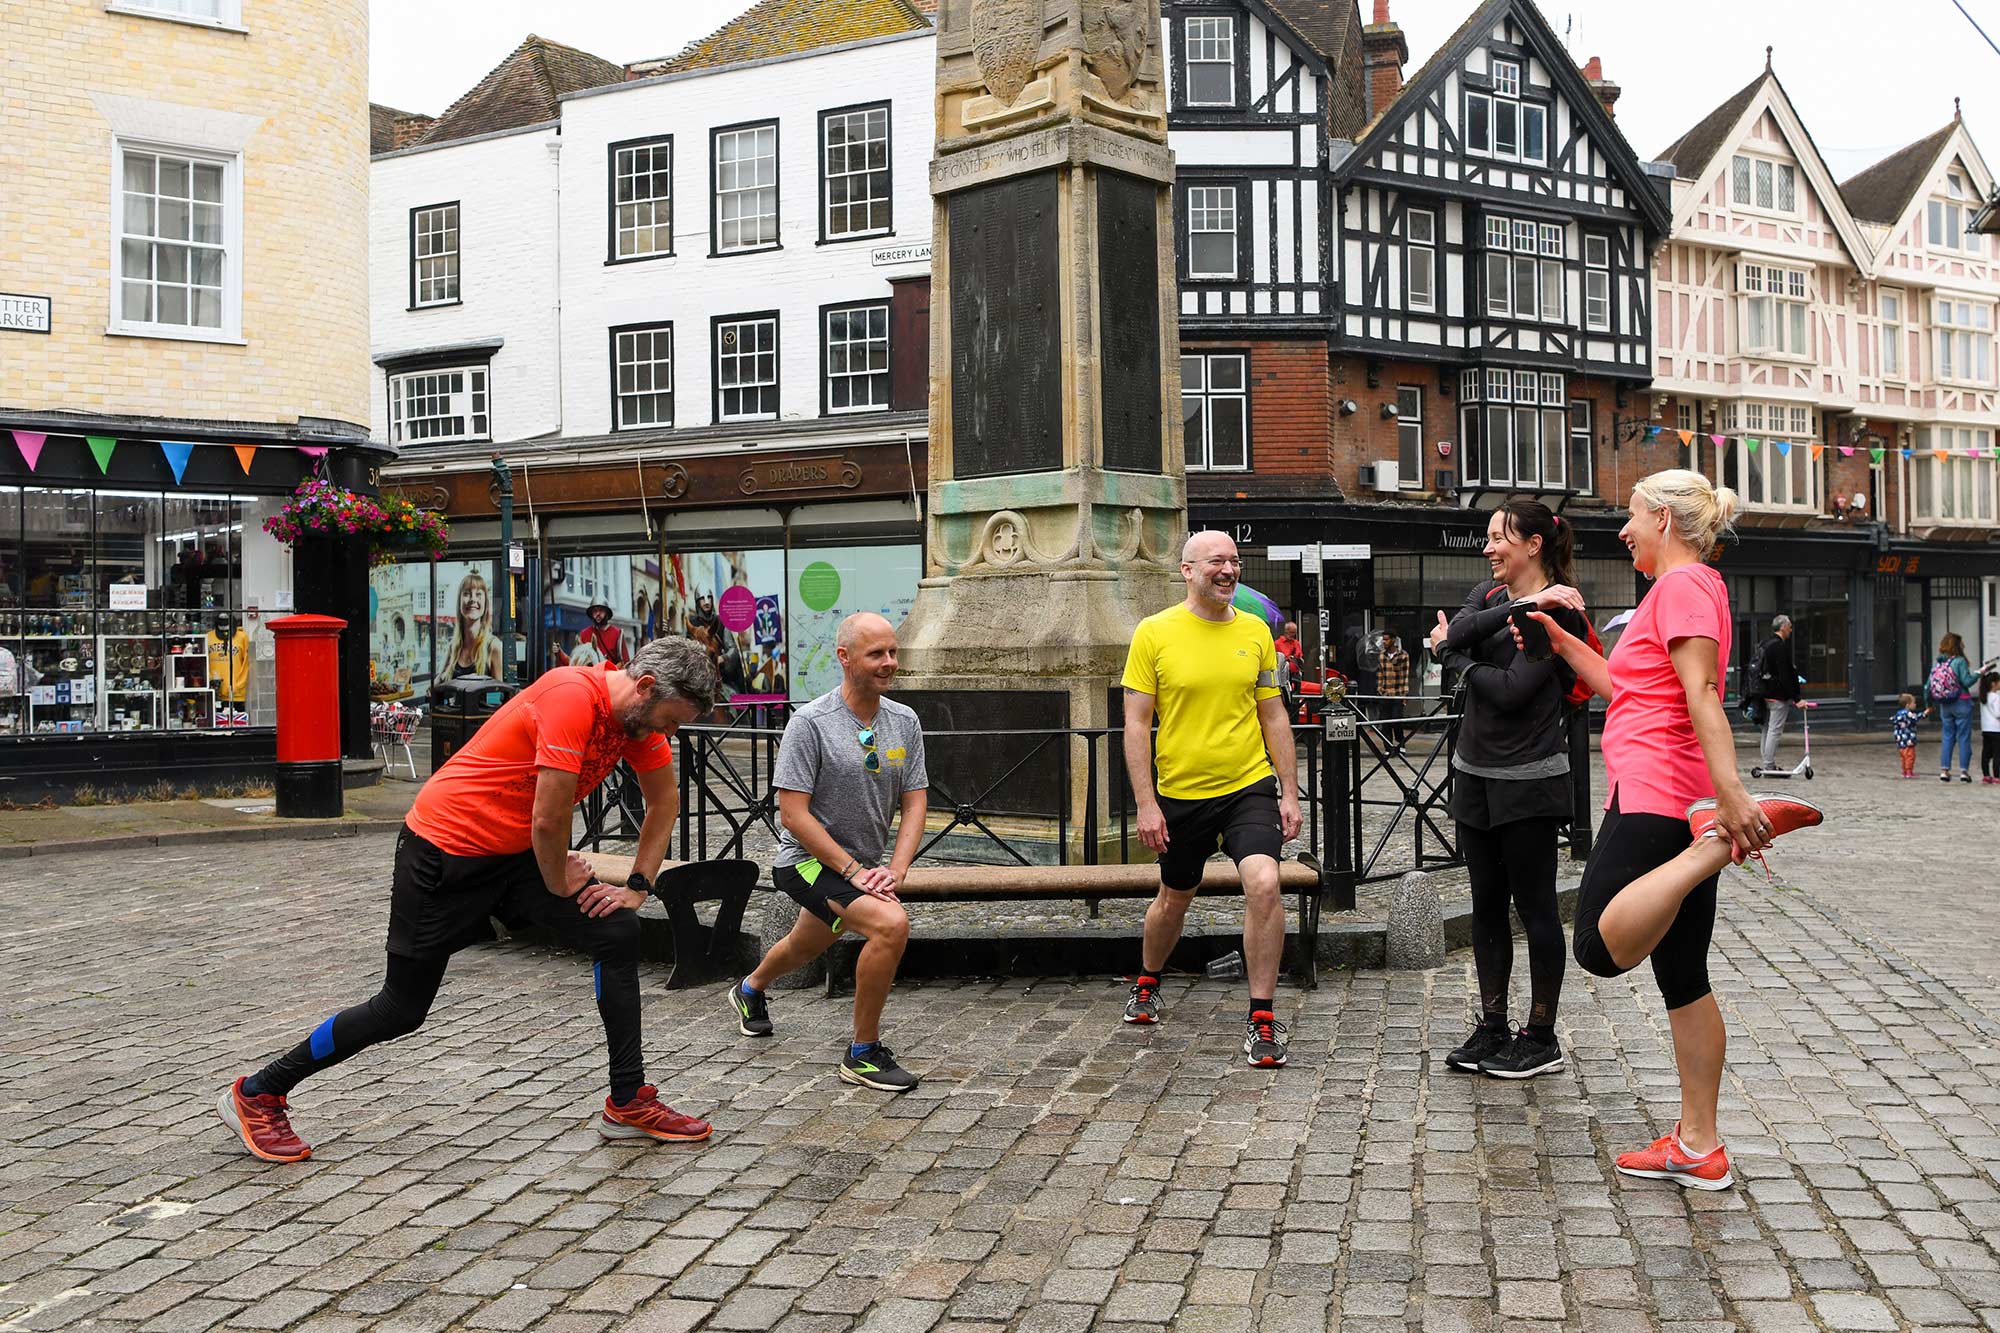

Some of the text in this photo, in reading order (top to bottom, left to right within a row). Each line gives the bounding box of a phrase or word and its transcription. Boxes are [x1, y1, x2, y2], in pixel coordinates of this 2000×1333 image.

[1093, 137, 1108, 155] THE
[936, 166, 948, 182] OF
[1006, 146, 1029, 163] WHO
[1032, 139, 1049, 158] FELL
[1051, 137, 1061, 153] IN
[875, 247, 932, 261] MERCERY LAN
[0, 313, 45, 327] RKET
[769, 464, 828, 484] DRAPERS
[1234, 523, 1252, 543] 12
[1438, 529, 1488, 548] Number
